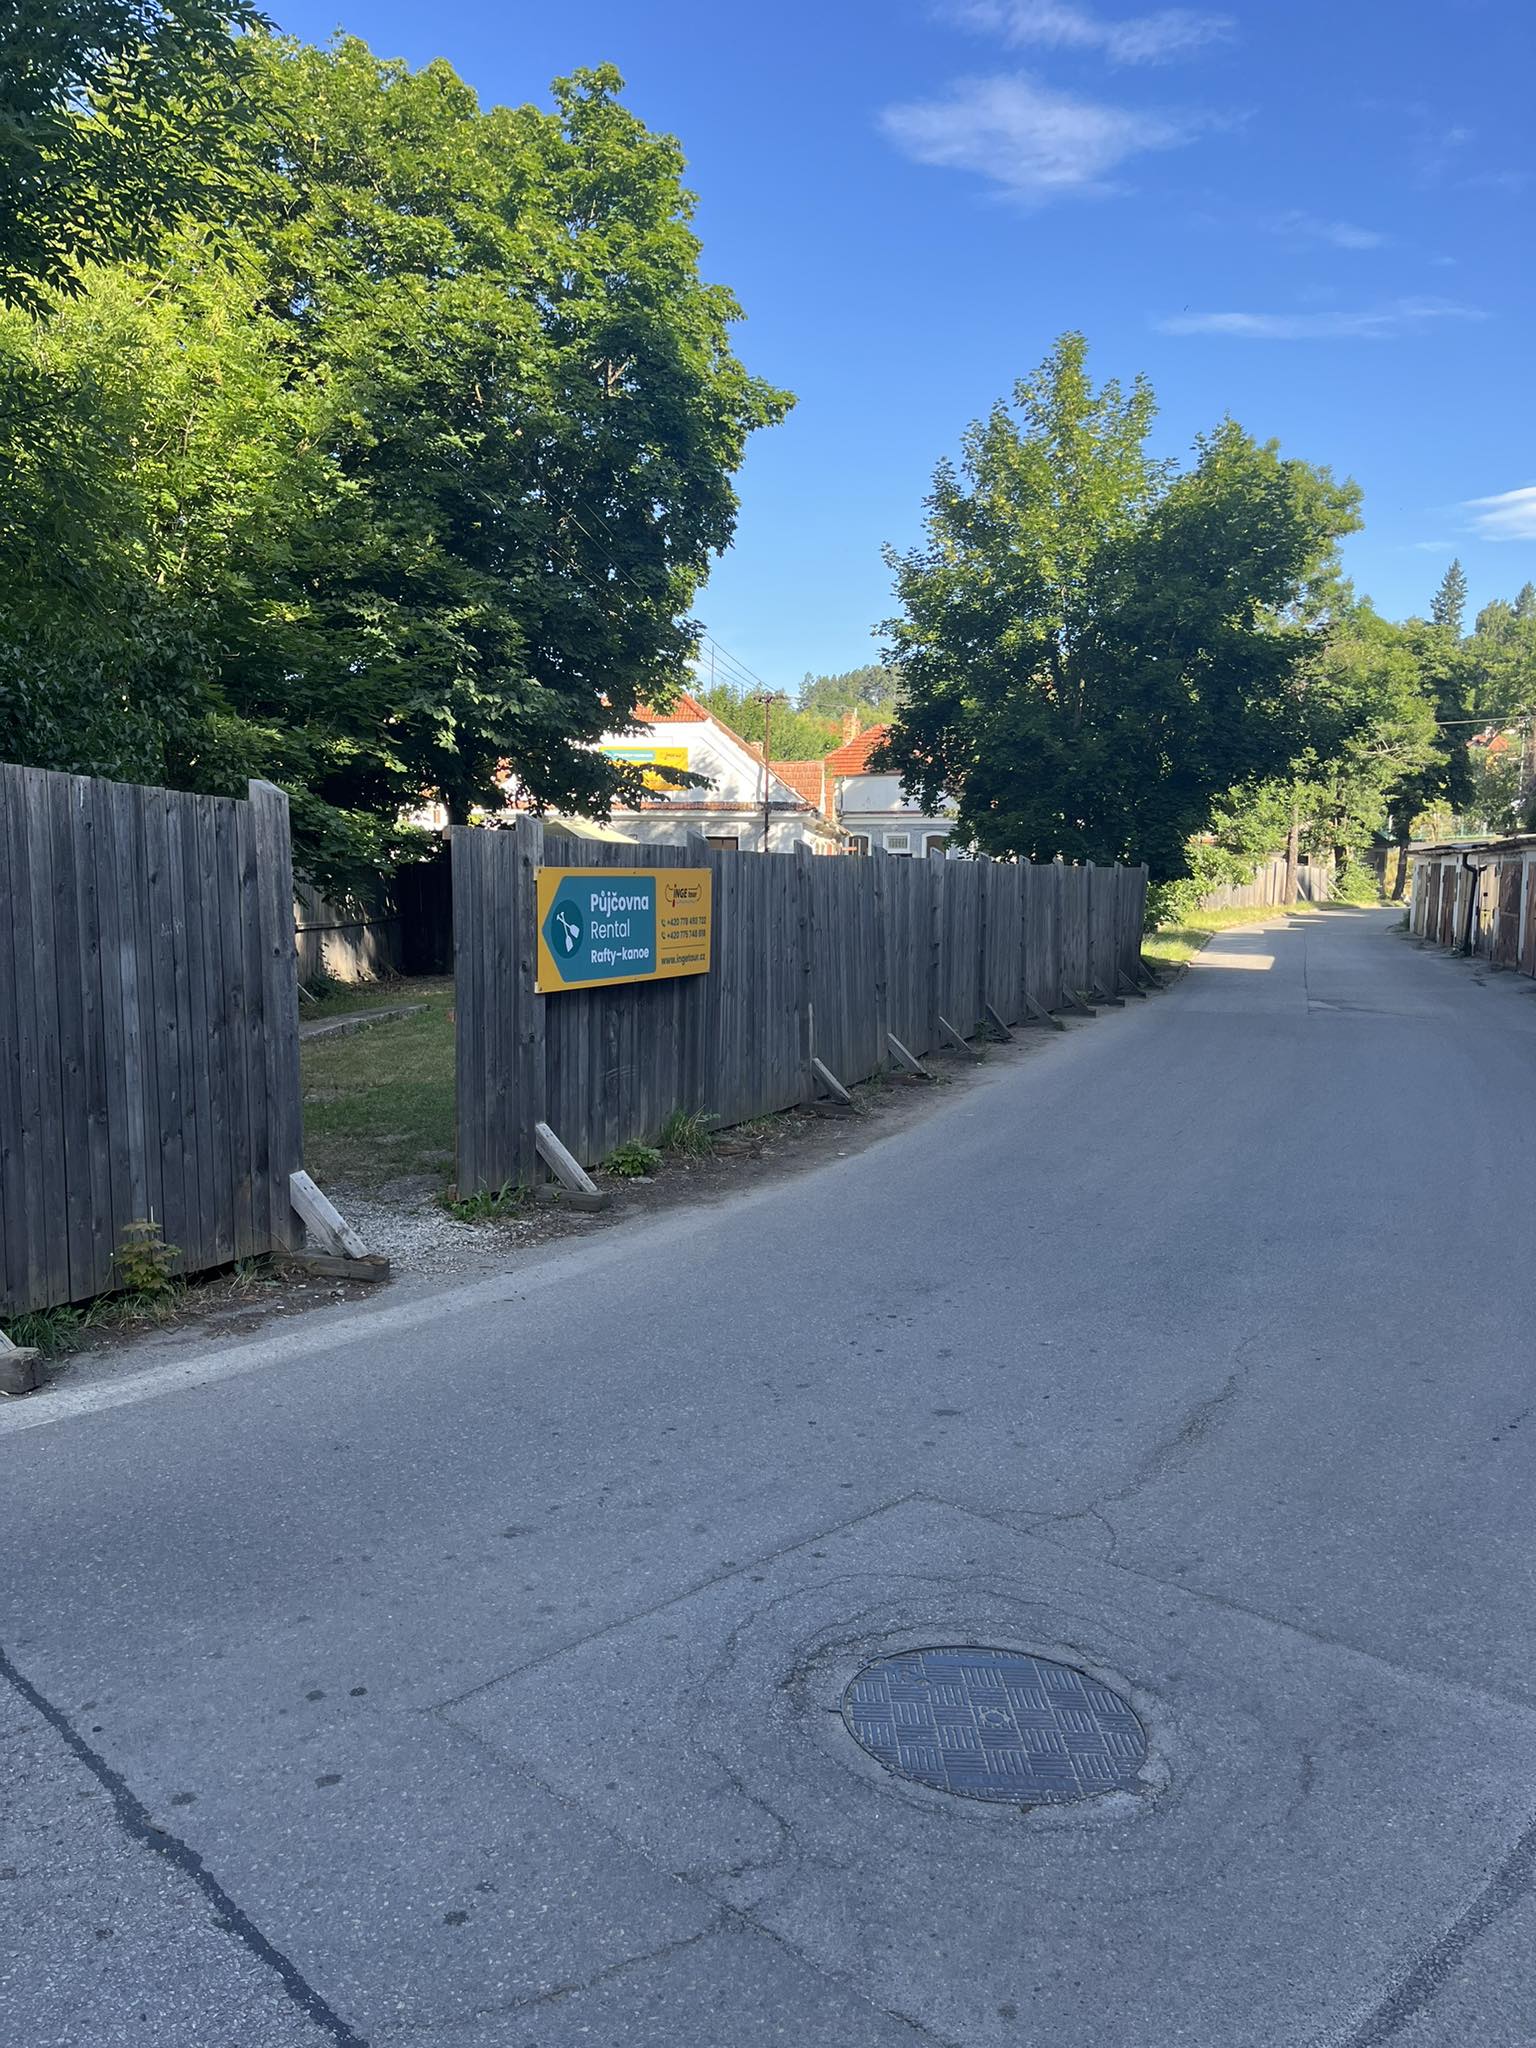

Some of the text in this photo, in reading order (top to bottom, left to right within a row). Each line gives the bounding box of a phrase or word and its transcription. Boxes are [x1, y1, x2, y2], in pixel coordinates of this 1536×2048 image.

[590, 890, 649, 918] Půjčovna
[591, 918, 630, 939] Rental
[591, 946, 650, 966] Rafty-kanoe
